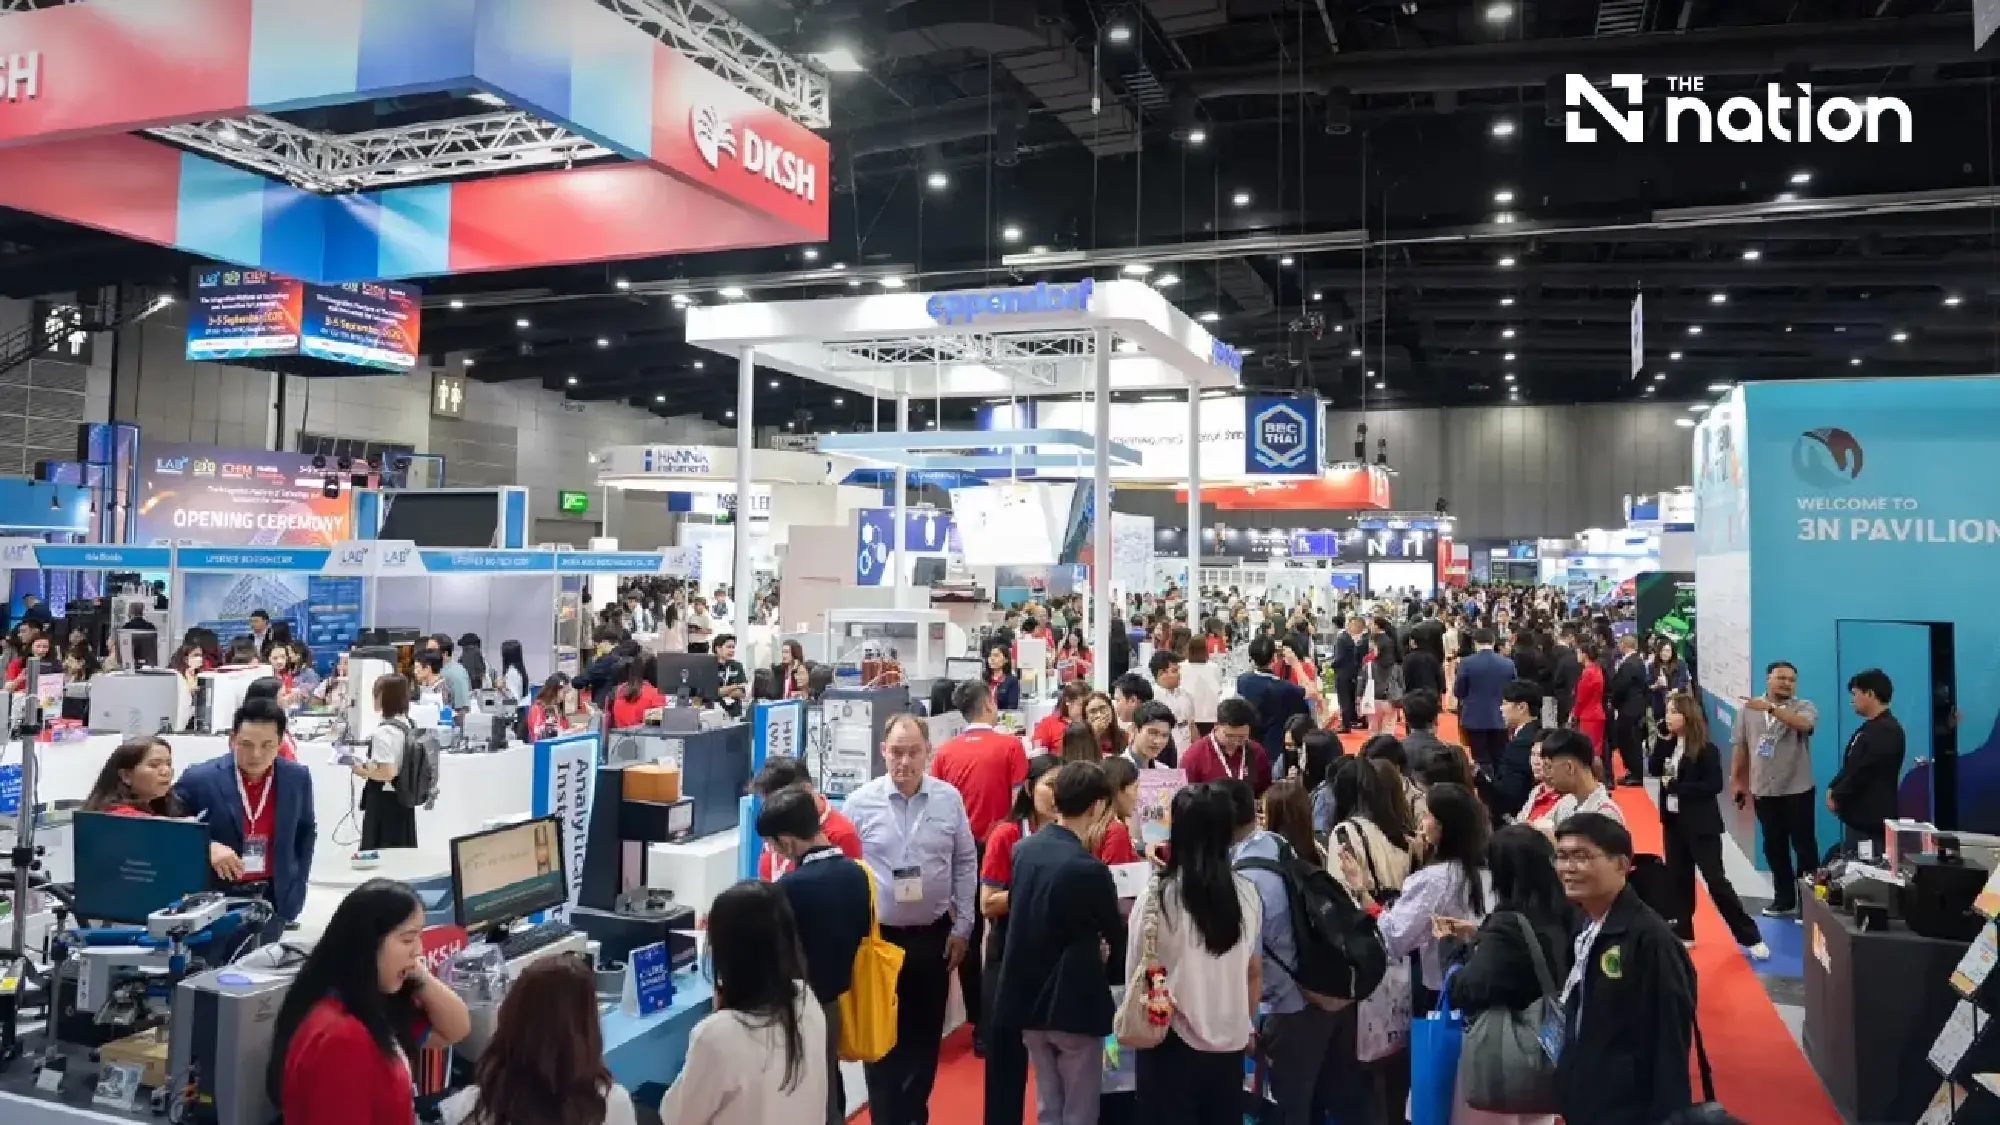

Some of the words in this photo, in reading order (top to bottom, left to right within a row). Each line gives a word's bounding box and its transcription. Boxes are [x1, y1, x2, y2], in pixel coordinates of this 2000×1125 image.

[742, 128, 815, 201] DKSH
[926, 276, 1095, 326] eppendorf
[1265, 433, 1298, 444] THAI
[1796, 497, 1887, 511] WELCOME
[1894, 498, 1918, 510] TO
[173, 508, 254, 529] OPENING
[256, 513, 344, 532] CEREMONY
[1797, 516, 1841, 541] 3N
[571, 758, 589, 890] Analytical
